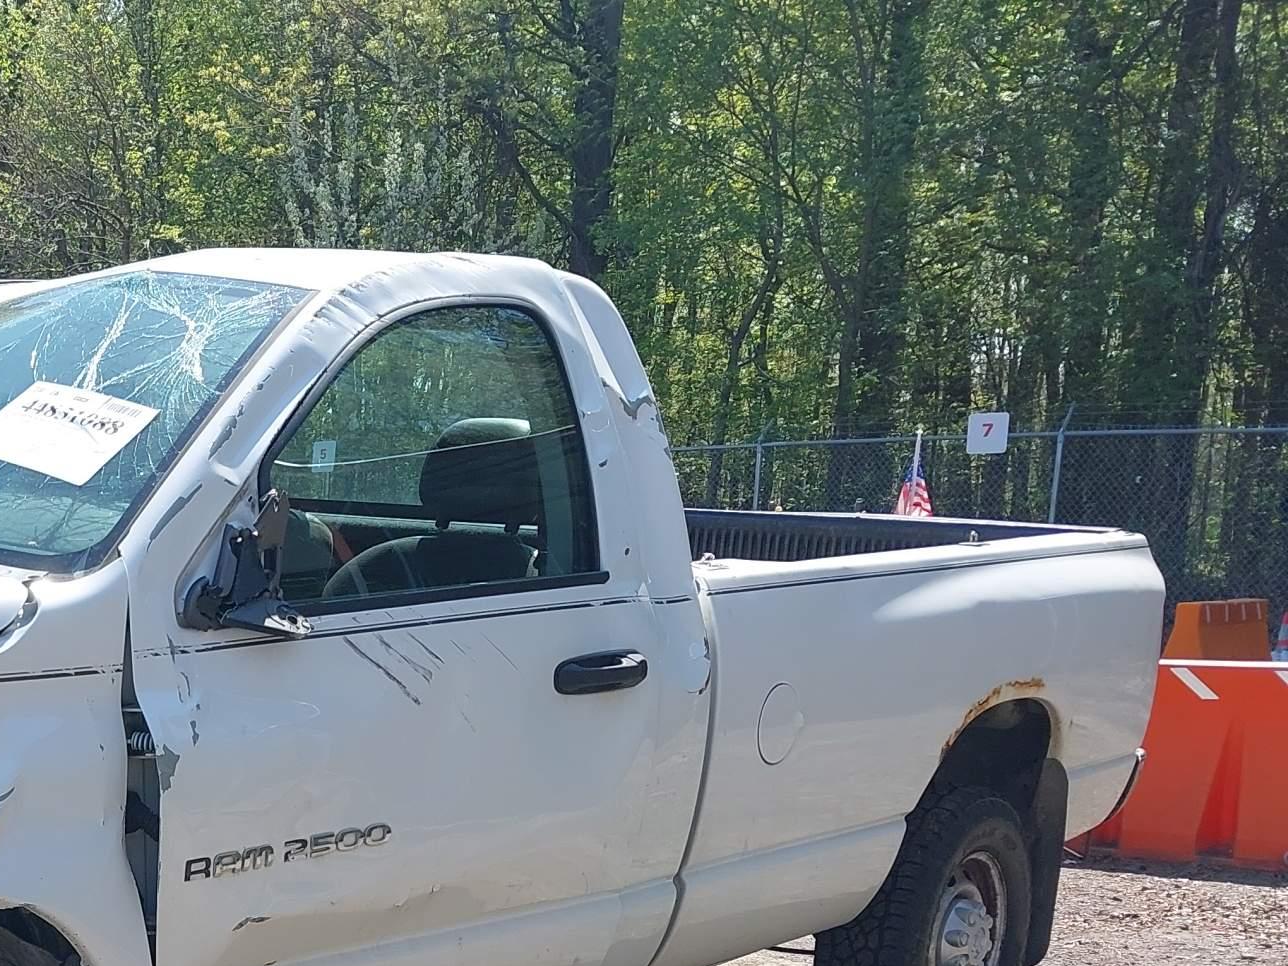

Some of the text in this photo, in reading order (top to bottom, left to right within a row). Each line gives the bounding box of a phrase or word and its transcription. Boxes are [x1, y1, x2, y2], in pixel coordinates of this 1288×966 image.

[982, 423, 993, 437] 7
[184, 822, 392, 882] RAM 2500
